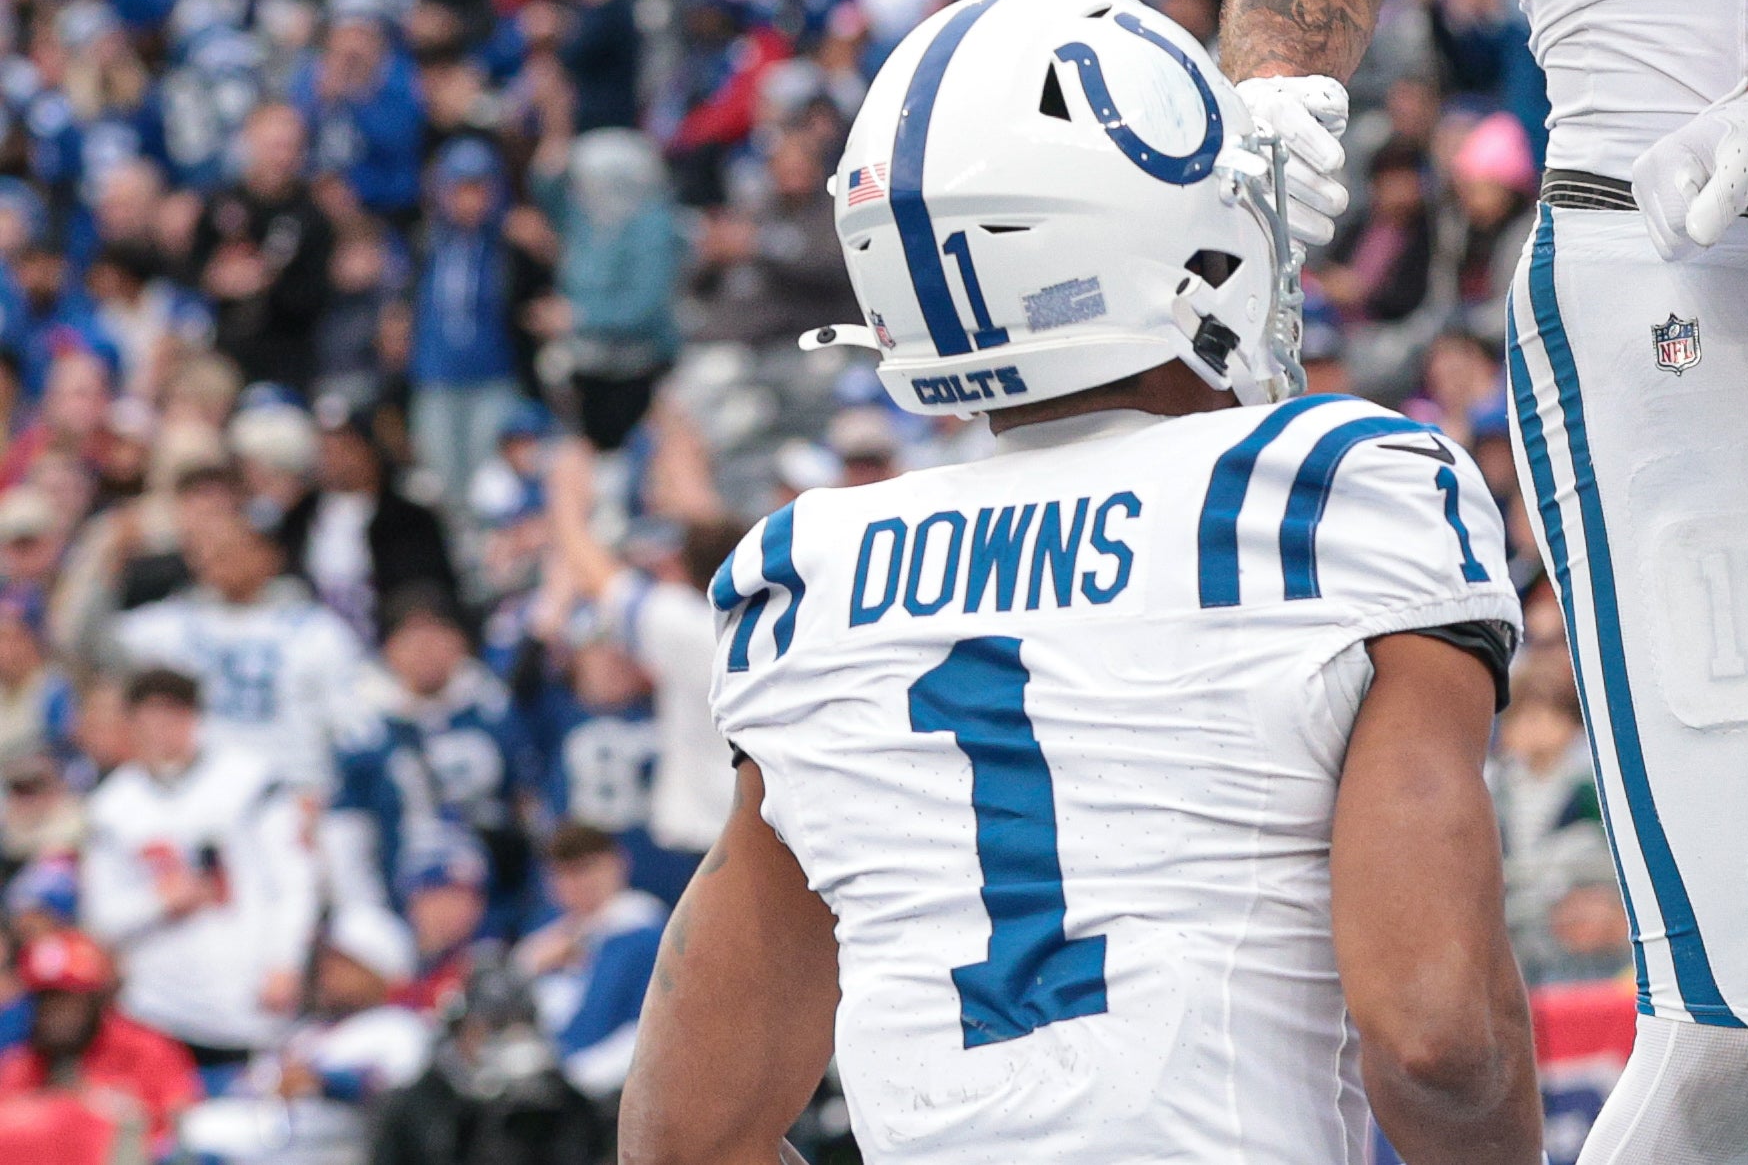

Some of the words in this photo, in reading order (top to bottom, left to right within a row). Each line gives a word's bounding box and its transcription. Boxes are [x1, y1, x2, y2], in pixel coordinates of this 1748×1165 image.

[942, 230, 1010, 351] 1
[911, 365, 1028, 406] COLTS
[1660, 339, 1693, 365] NFL
[849, 490, 1143, 628] DOWNS
[1434, 465, 1491, 584] 1
[908, 636, 1108, 1050] 1
